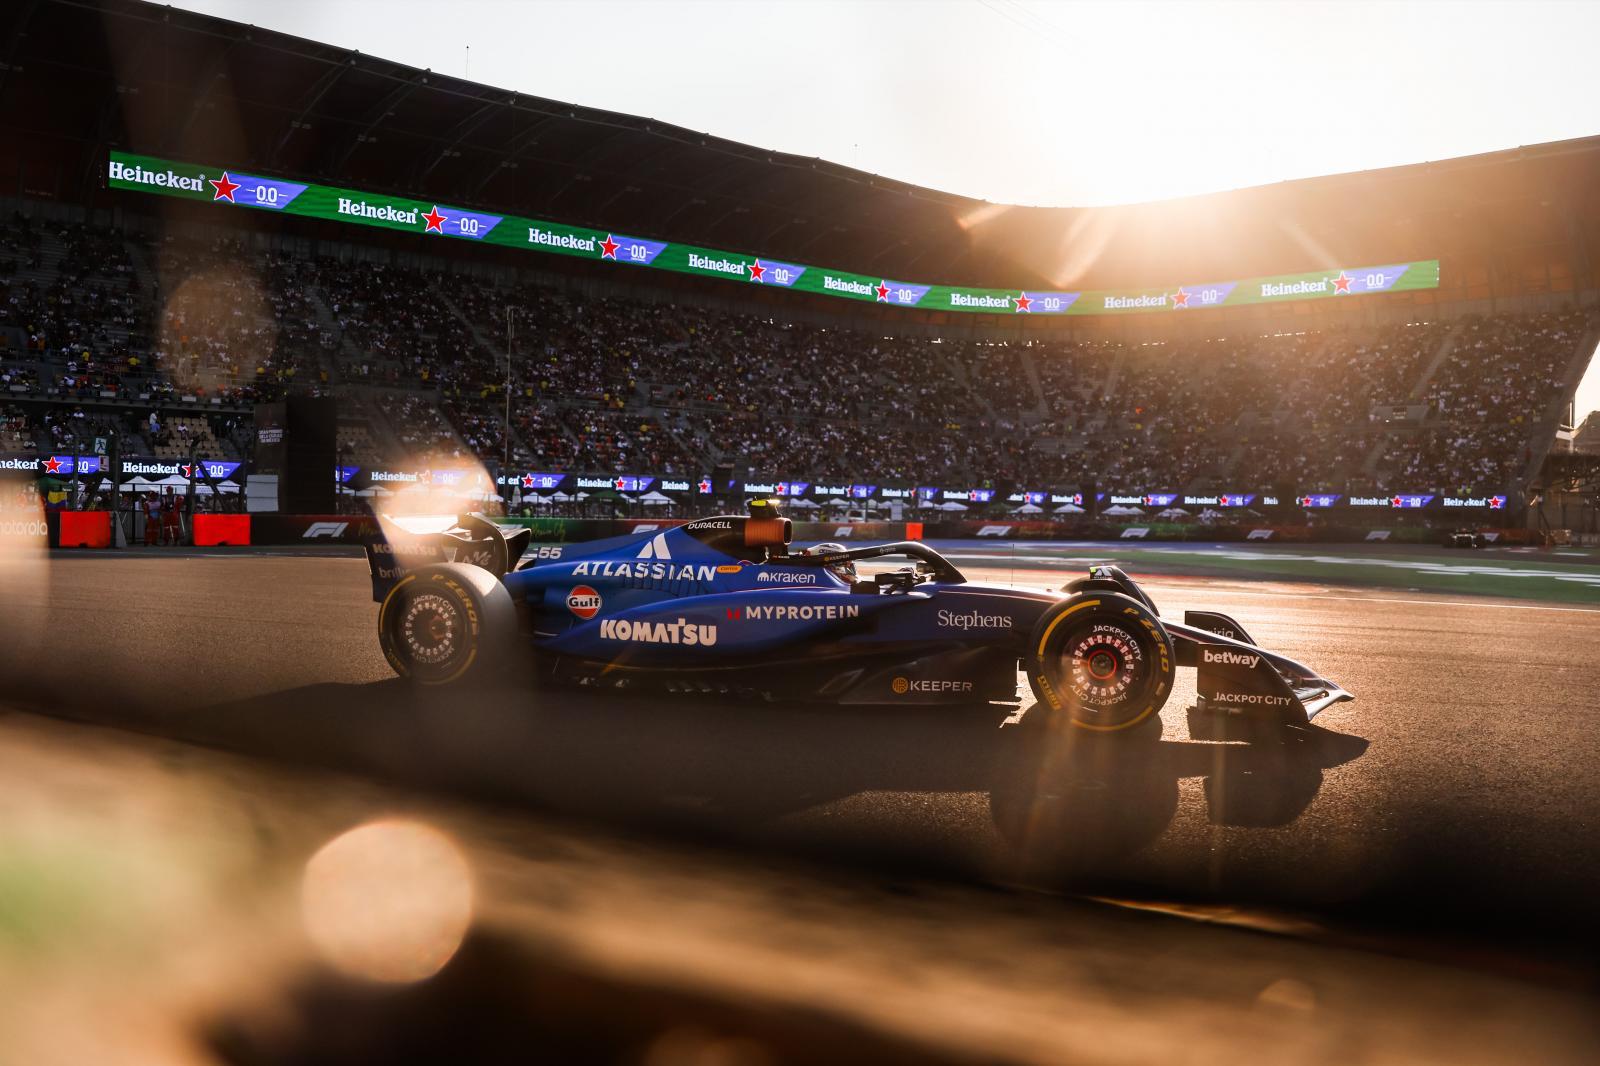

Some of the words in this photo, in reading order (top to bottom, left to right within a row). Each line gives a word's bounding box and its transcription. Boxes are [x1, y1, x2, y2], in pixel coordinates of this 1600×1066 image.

[688, 521, 732, 530] DURACELL
[538, 546, 563, 559] 55
[571, 561, 718, 582] ATLASSIAN
[569, 597, 599, 608] Gulf
[745, 605, 858, 620] MYPROTEIN
[937, 610, 1012, 630] Stephens
[600, 618, 716, 646] KOMATSU
[1092, 625, 1131, 640] JACKPOT
[1129, 640, 1143, 661] CITY
[1203, 650, 1260, 669] betway
[911, 680, 973, 691] KEEPER
[1213, 692, 1263, 704] JACKPOT
[1264, 695, 1292, 706] CITY
